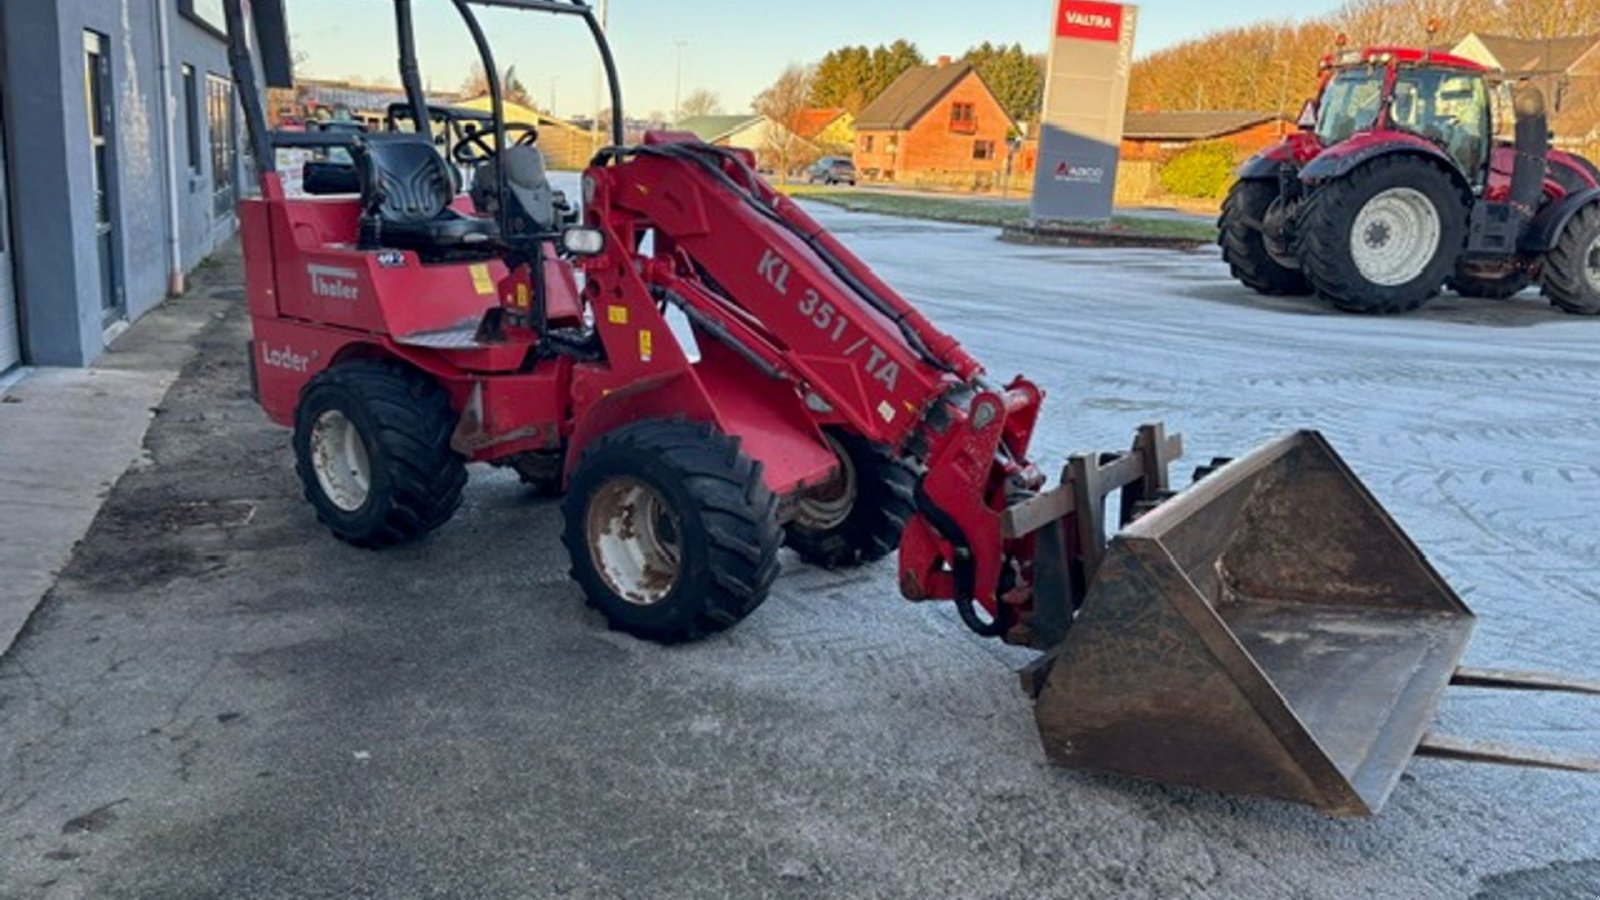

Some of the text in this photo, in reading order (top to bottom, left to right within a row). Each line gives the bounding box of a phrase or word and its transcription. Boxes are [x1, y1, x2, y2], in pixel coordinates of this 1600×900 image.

[1065, 11, 1112, 29] VALTRA
[308, 263, 358, 299] Thaler
[757, 249, 791, 296] KL
[798, 288, 849, 342] 351
[864, 345, 900, 392] TA
